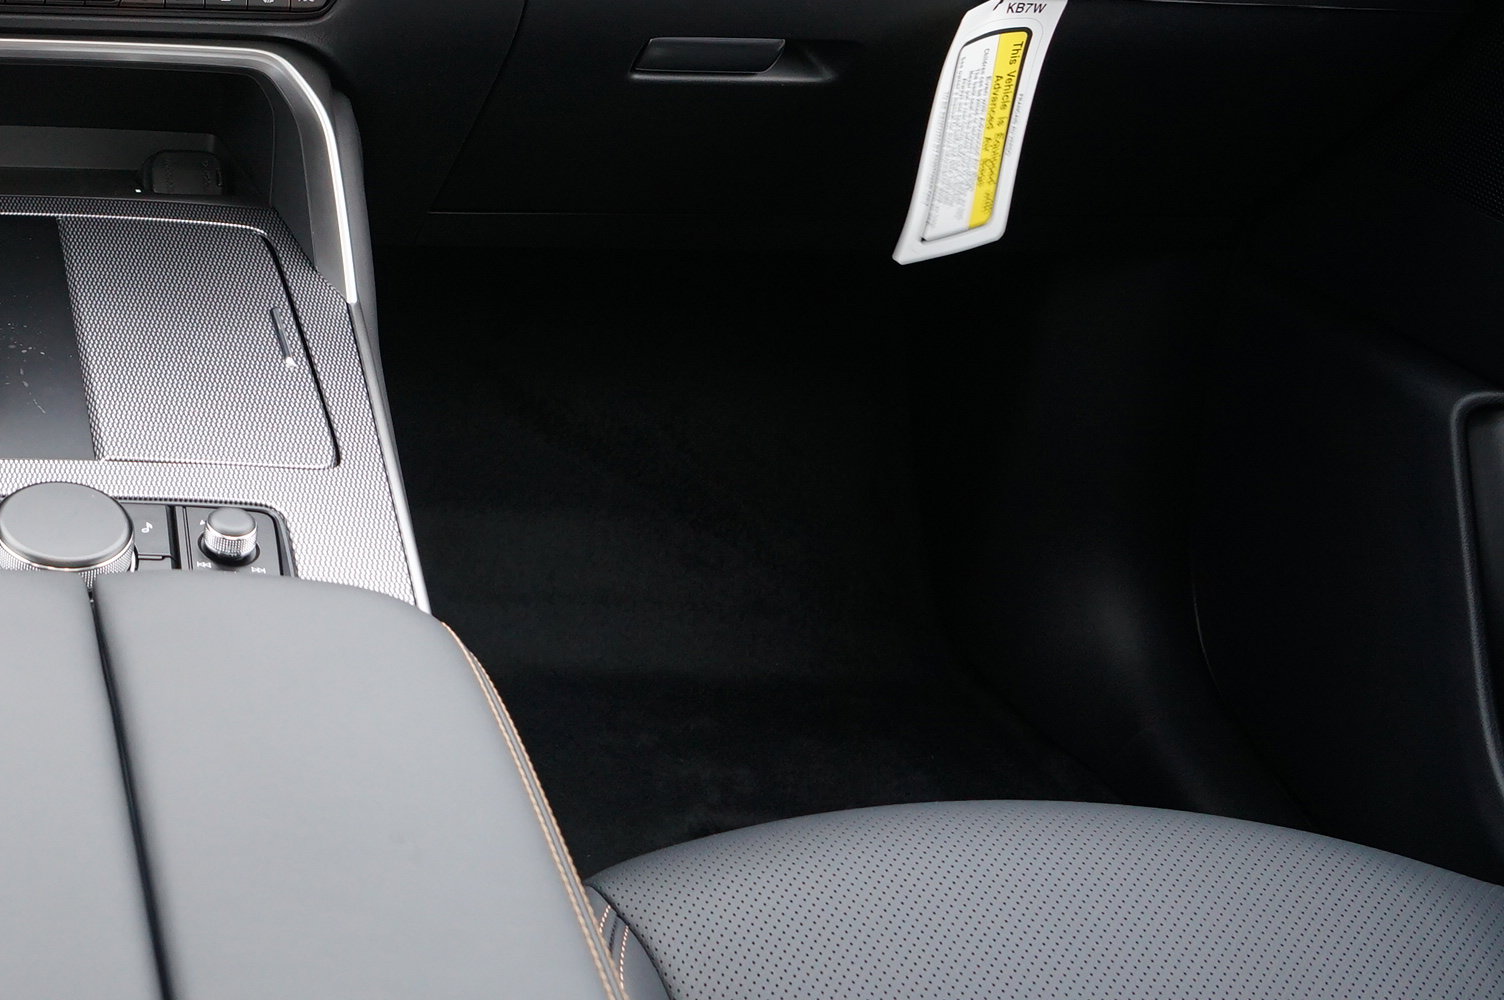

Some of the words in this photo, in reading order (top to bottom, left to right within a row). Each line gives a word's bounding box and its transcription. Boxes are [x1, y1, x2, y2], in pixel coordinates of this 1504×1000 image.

[1006, 2, 1047, 14] KB7W
[1009, 40, 1024, 66] This
[1000, 70, 1016, 110] Vehicle
